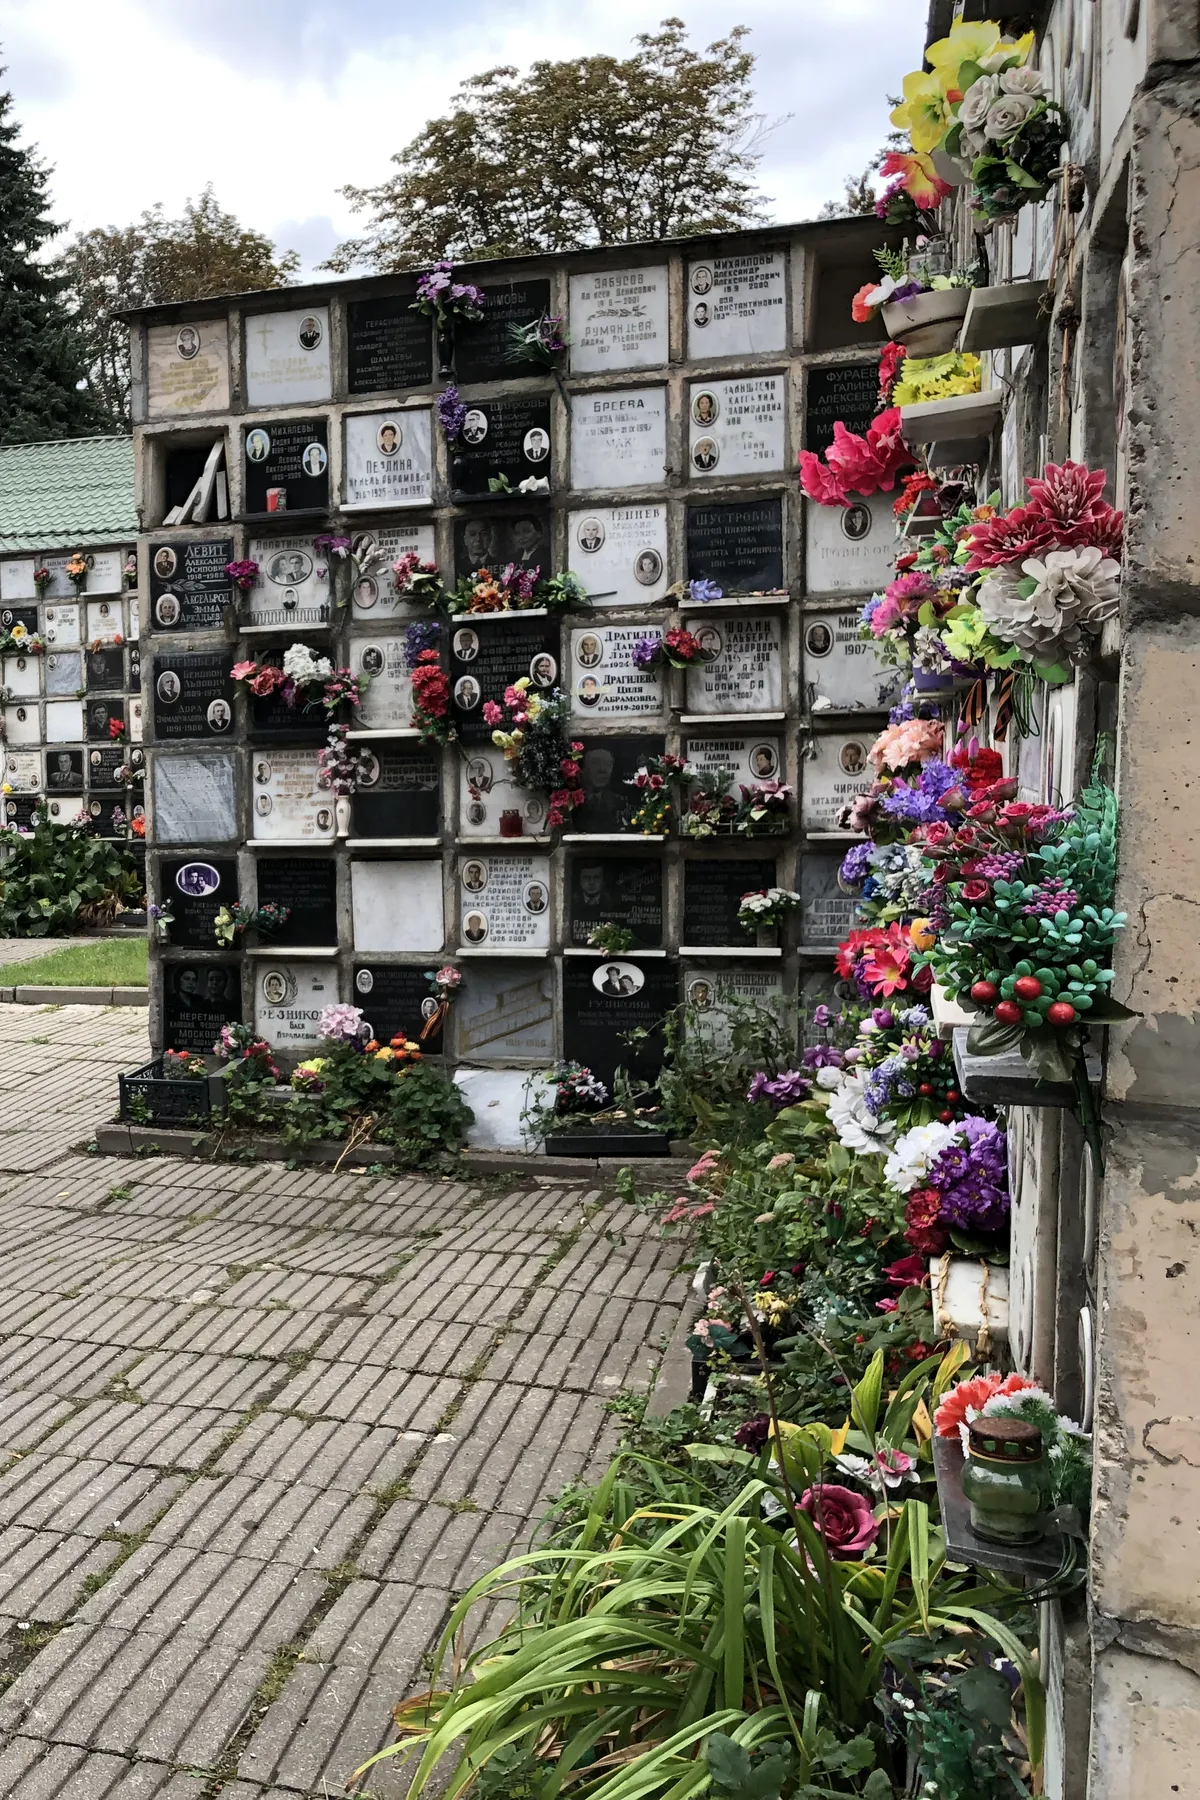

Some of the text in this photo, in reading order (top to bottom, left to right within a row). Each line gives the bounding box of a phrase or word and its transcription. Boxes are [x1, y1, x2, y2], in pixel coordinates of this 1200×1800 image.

[712, 267, 760, 279] АЛЕКСАНДР
[594, 273, 644, 289] ЗАБУСОВ
[371, 353, 412, 364] ШАМАЕВЫ
[826, 368, 878, 382] ФУРАЕВ
[833, 380, 878, 393] ГАЛИНА
[817, 391, 877, 405] АЛЕКСЕЕВ
[490, 398, 548, 412] ШЛЯХОВЫ
[270, 423, 314, 437] МИХАЛЕВЫ
[695, 510, 773, 526] ШУСТРОВЫ
[255, 538, 315, 551] ЛОПАТИНСКИ
[184, 544, 228, 558] ЛЕВИТ
[184, 557, 228, 567] АЛЕКСАНДР
[186, 564, 226, 574] ОСИПОВИ
[183, 593, 231, 605] АКСЕЛЬРОД
[192, 605, 222, 614] ЭММА
[179, 611, 224, 623] АРКАДЬЕВ
[724, 620, 772, 633] ШОЛИН
[159, 655, 225, 669] ШТЕЙНБЕРГ
[183, 669, 224, 679] БЕНЦИОН
[602, 674, 657, 686] ДРАГИЛЕВА
[183, 678, 226, 689] ЛЬВОВИЧ
[616, 685, 643, 695] ЦИЛЯ
[603, 694, 657, 704] АБРАМОВНА
[833, 782, 869, 795] ЧИРКО
[179, 1011, 226, 1022] НЕРЕТИНА
[259, 1009, 323, 1020] РЕЗНИКО
